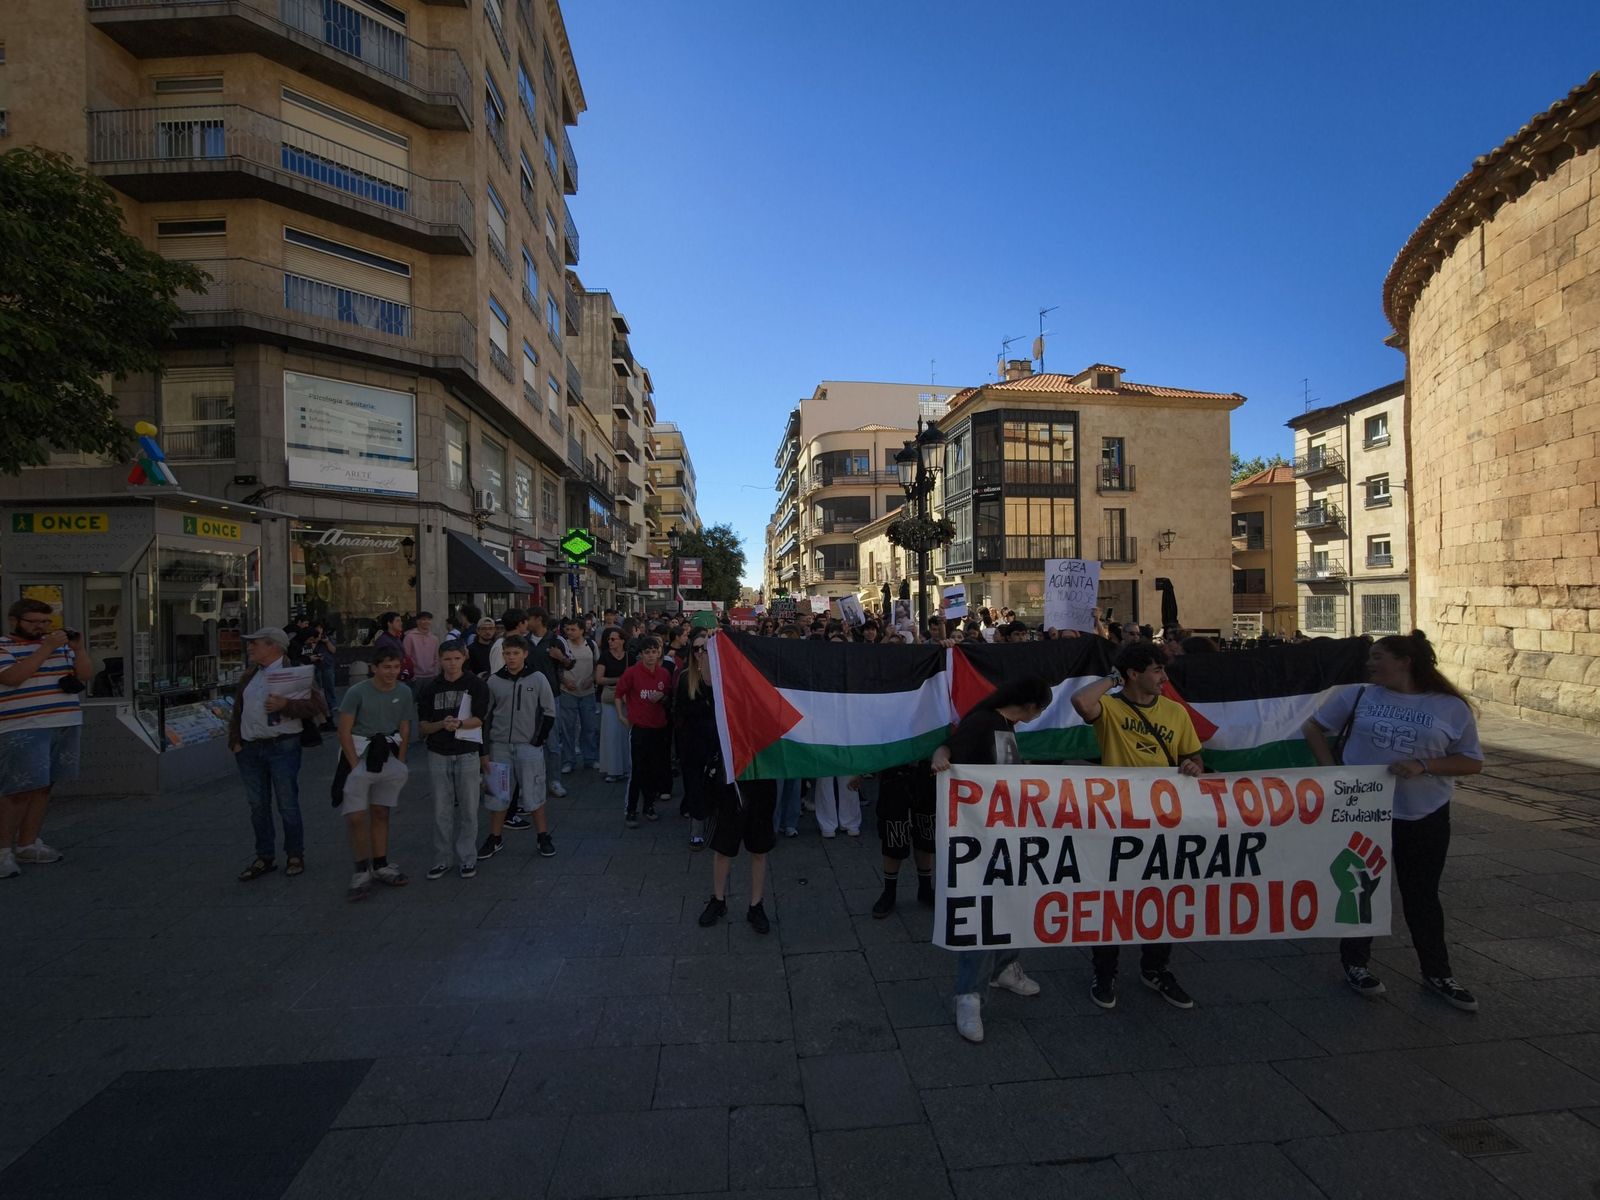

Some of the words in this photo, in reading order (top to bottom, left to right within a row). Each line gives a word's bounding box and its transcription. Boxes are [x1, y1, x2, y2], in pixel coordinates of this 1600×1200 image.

[41, 515, 101, 530] ONCE
[202, 521, 237, 538] ONCE
[1059, 561, 1086, 573] GAZA
[1367, 705, 1433, 728] CHICAGO
[1372, 720, 1417, 754] 92
[1334, 778, 1383, 795] Sindicato
[948, 778, 1182, 829] PARARLO
[1199, 777, 1324, 827] TODO
[1346, 795, 1358, 806] de
[1331, 808, 1392, 822] Estudiantes
[948, 835, 1081, 888] PARA
[1108, 832, 1267, 882] PARAR
[945, 895, 1011, 946] EL
[1033, 880, 1319, 943] GENOCIDIO
